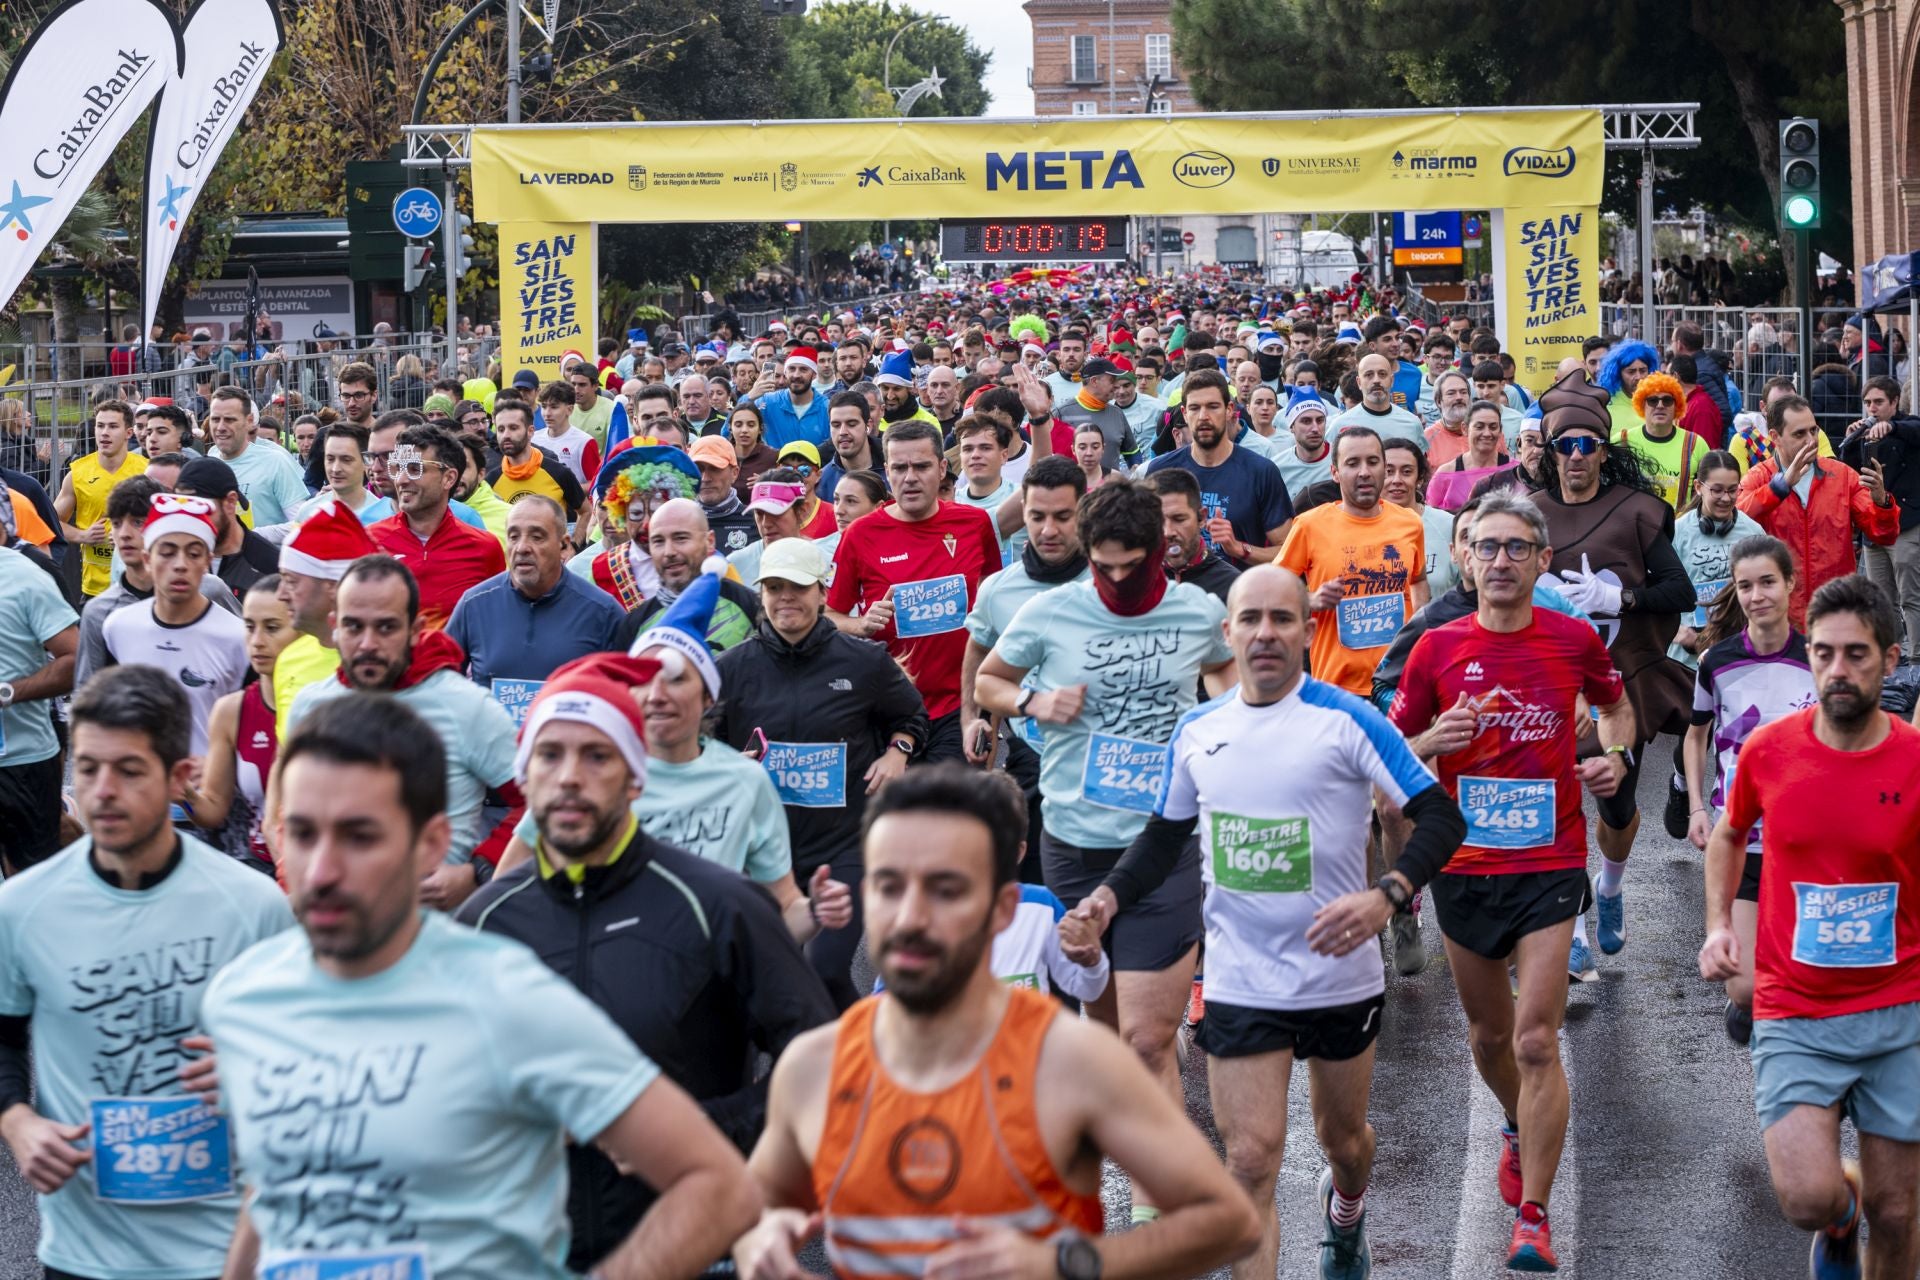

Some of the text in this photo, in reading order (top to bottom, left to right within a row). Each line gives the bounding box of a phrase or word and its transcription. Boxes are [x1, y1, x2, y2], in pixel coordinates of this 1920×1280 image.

[33, 48, 150, 180] CaixaBank
[177, 41, 266, 170] CaixaBank
[986, 149, 1145, 191] META
[1180, 163, 1228, 176] Juver
[1288, 157, 1361, 168] UNIVERSAE
[1410, 156, 1477, 169] marmo
[1513, 156, 1567, 169] VIDAL
[520, 172, 614, 185] LA VERDAD
[810, 178, 835, 186] Murcia
[888, 166, 967, 182] CaixaBank
[985, 223, 1107, 252] 0:00:19
[1422, 228, 1447, 240] 24h
[1520, 212, 1583, 245] SAN
[514, 234, 576, 266] SAN
[1529, 237, 1574, 267] SIL
[524, 258, 568, 287] SIL
[1523, 258, 1581, 290] VES
[276, 288, 332, 299] AVANZADA
[517, 278, 575, 310] VES
[1525, 282, 1582, 313] TRE
[210, 301, 310, 313] Y ESTÉTA DENTAL
[1525, 303, 1587, 329] MURCIA
[519, 302, 577, 333] TRE
[520, 323, 582, 348] MURCIA
[1525, 335, 1585, 345] LA VERDAD
[520, 355, 562, 364] LA VER
[1202, 492, 1222, 506] SIL
[1208, 505, 1228, 519] VS
[880, 552, 909, 564] hummel
[899, 583, 925, 600] SAN
[900, 578, 960, 610] SILVESTRE
[936, 588, 961, 602] MURCIA
[1696, 583, 1717, 596] SAN
[908, 600, 958, 621] 2298
[1344, 600, 1366, 614] SAN
[1344, 595, 1400, 623] SILVESTRE
[1376, 605, 1399, 617] MURCIA
[1350, 616, 1396, 635] 3724
[1083, 626, 1181, 671] SAN
[1099, 657, 1171, 700] SIL
[500, 683, 526, 696] SAN
[769, 747, 797, 761] SAN
[1098, 741, 1134, 755] SAN
[768, 747, 840, 772] SILVESTRE
[809, 758, 838, 772] MURCIA
[1094, 750, 1167, 768] SILVESTR
[776, 770, 830, 790] 1035
[1099, 766, 1163, 796] 2240
[1467, 783, 1548, 810] SILVESTRE
[1468, 783, 1500, 798] SAN
[1512, 795, 1546, 809] MURCIA
[1218, 819, 1249, 834] SAN
[1473, 808, 1540, 829] 2483
[1217, 820, 1302, 848] SILVESTRE
[1263, 835, 1301, 851] MURCIA
[1224, 847, 1294, 874] 1604
[1803, 887, 1890, 920] SILVESTRE
[1805, 890, 1837, 906] SAN
[1851, 903, 1888, 919] MURCIA
[1816, 920, 1873, 944] 562
[69, 936, 215, 1013] SAN
[97, 990, 196, 1057] SIL
[249, 1043, 425, 1122] SAN
[103, 1104, 150, 1127] SAN
[113, 1140, 211, 1175] 2876
[263, 1111, 382, 1187] SIL
